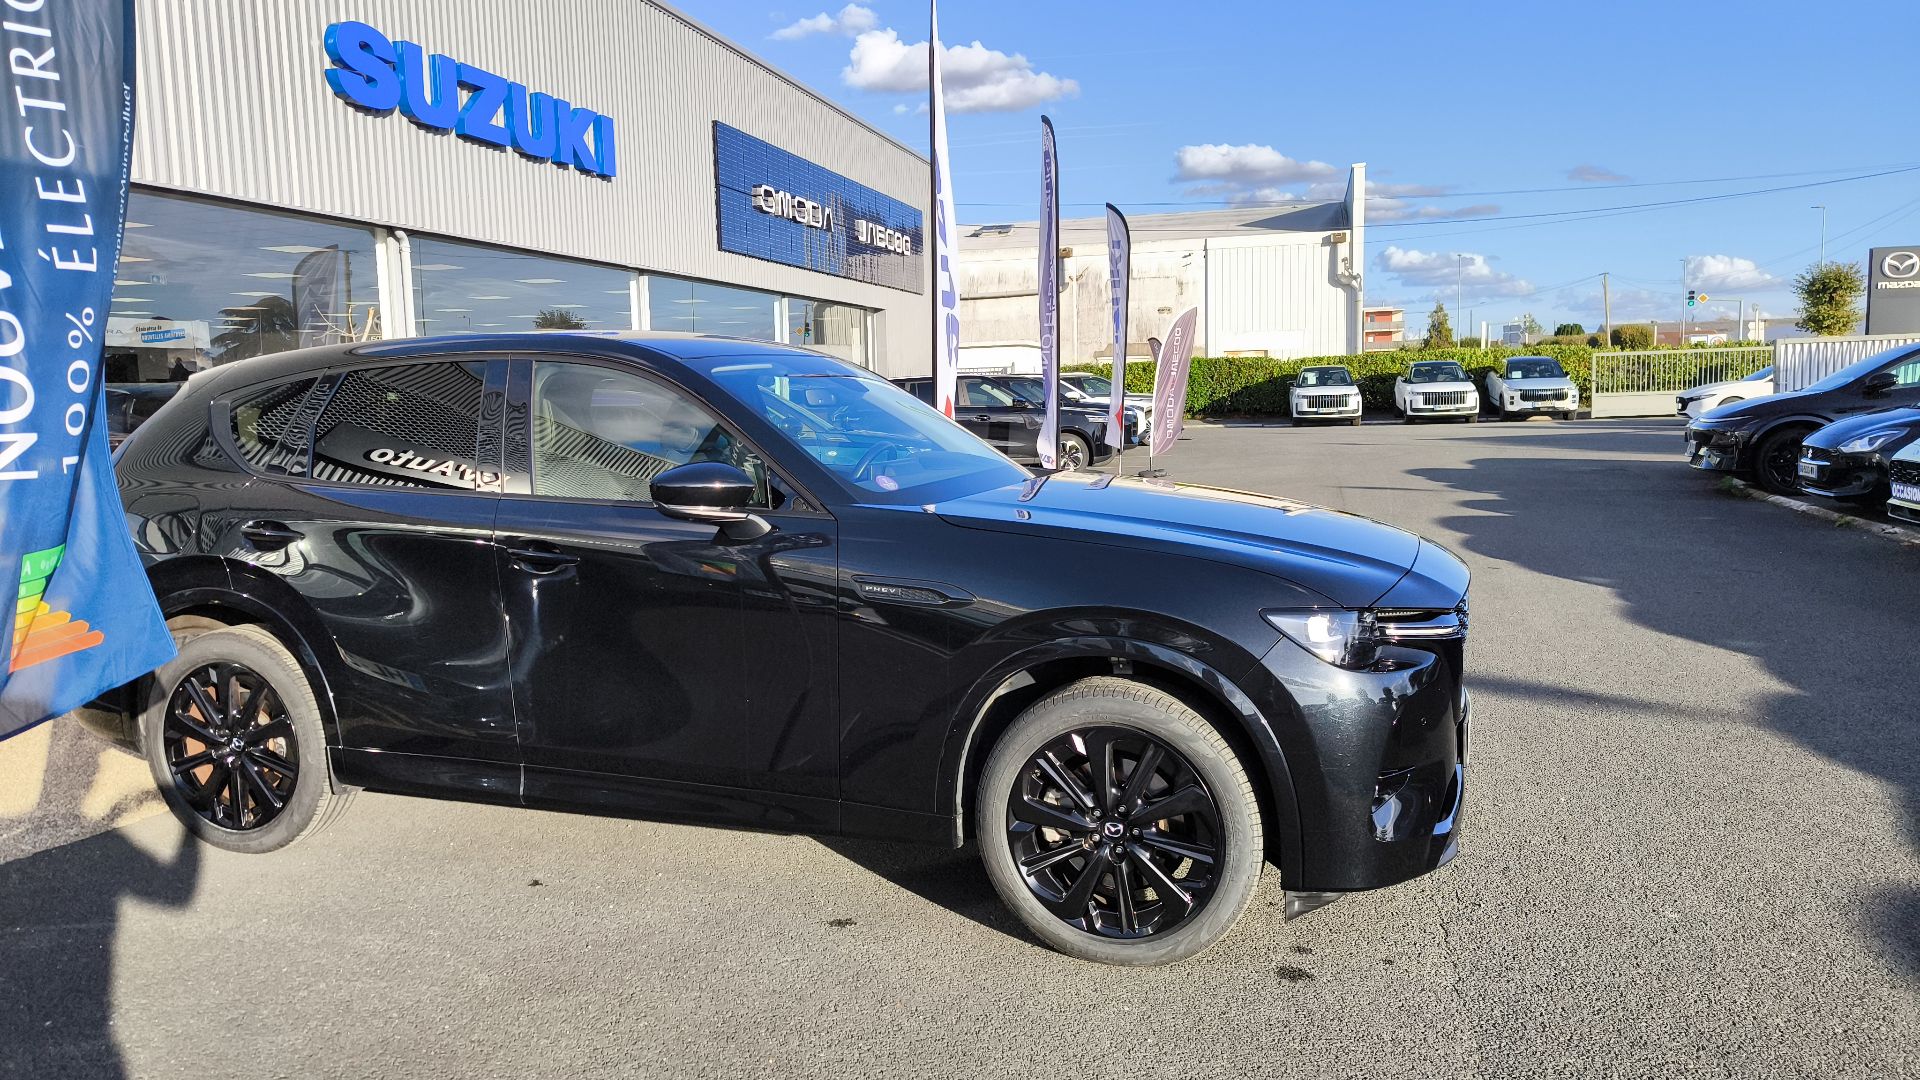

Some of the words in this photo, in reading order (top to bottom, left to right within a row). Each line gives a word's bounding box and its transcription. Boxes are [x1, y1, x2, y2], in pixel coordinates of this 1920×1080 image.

[3, 0, 97, 272] ÉLECTRI
[324, 20, 617, 177] SUZUKI
[752, 184, 834, 232] OMODA
[855, 219, 911, 256] JAECOO
[62, 306, 95, 474] 100%
[865, 585, 896, 593] PHEV
